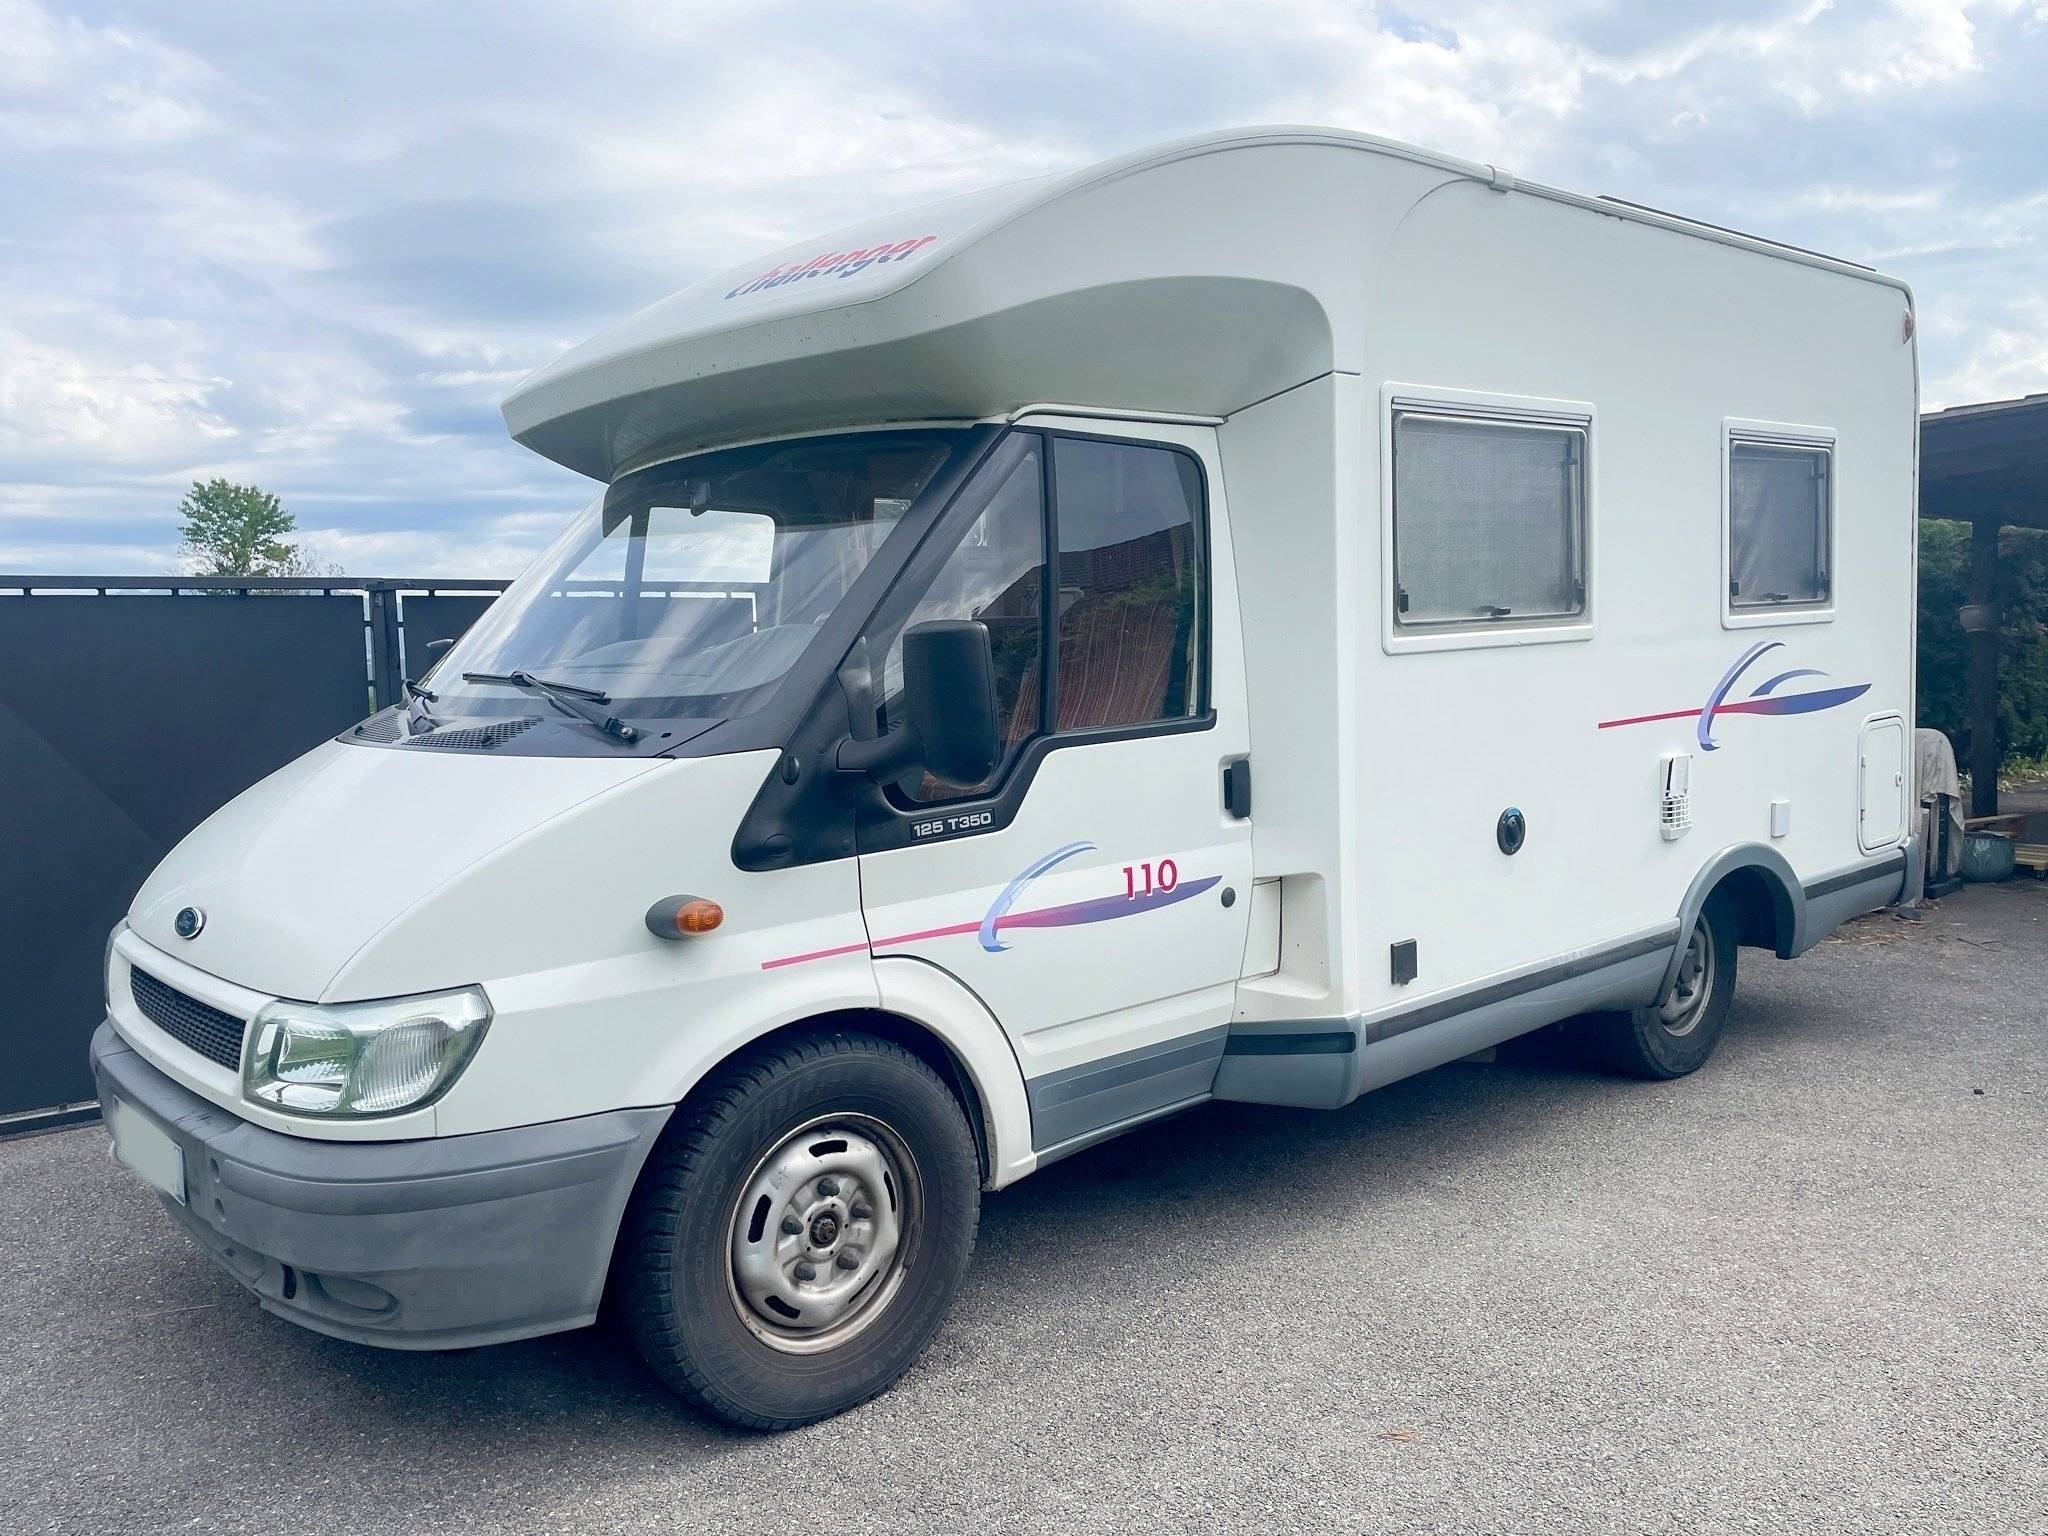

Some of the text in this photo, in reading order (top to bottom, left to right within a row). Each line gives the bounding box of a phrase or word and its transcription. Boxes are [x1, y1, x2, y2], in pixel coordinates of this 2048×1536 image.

[913, 812, 992, 837] 125 T350
[1122, 859, 1178, 899] 110
